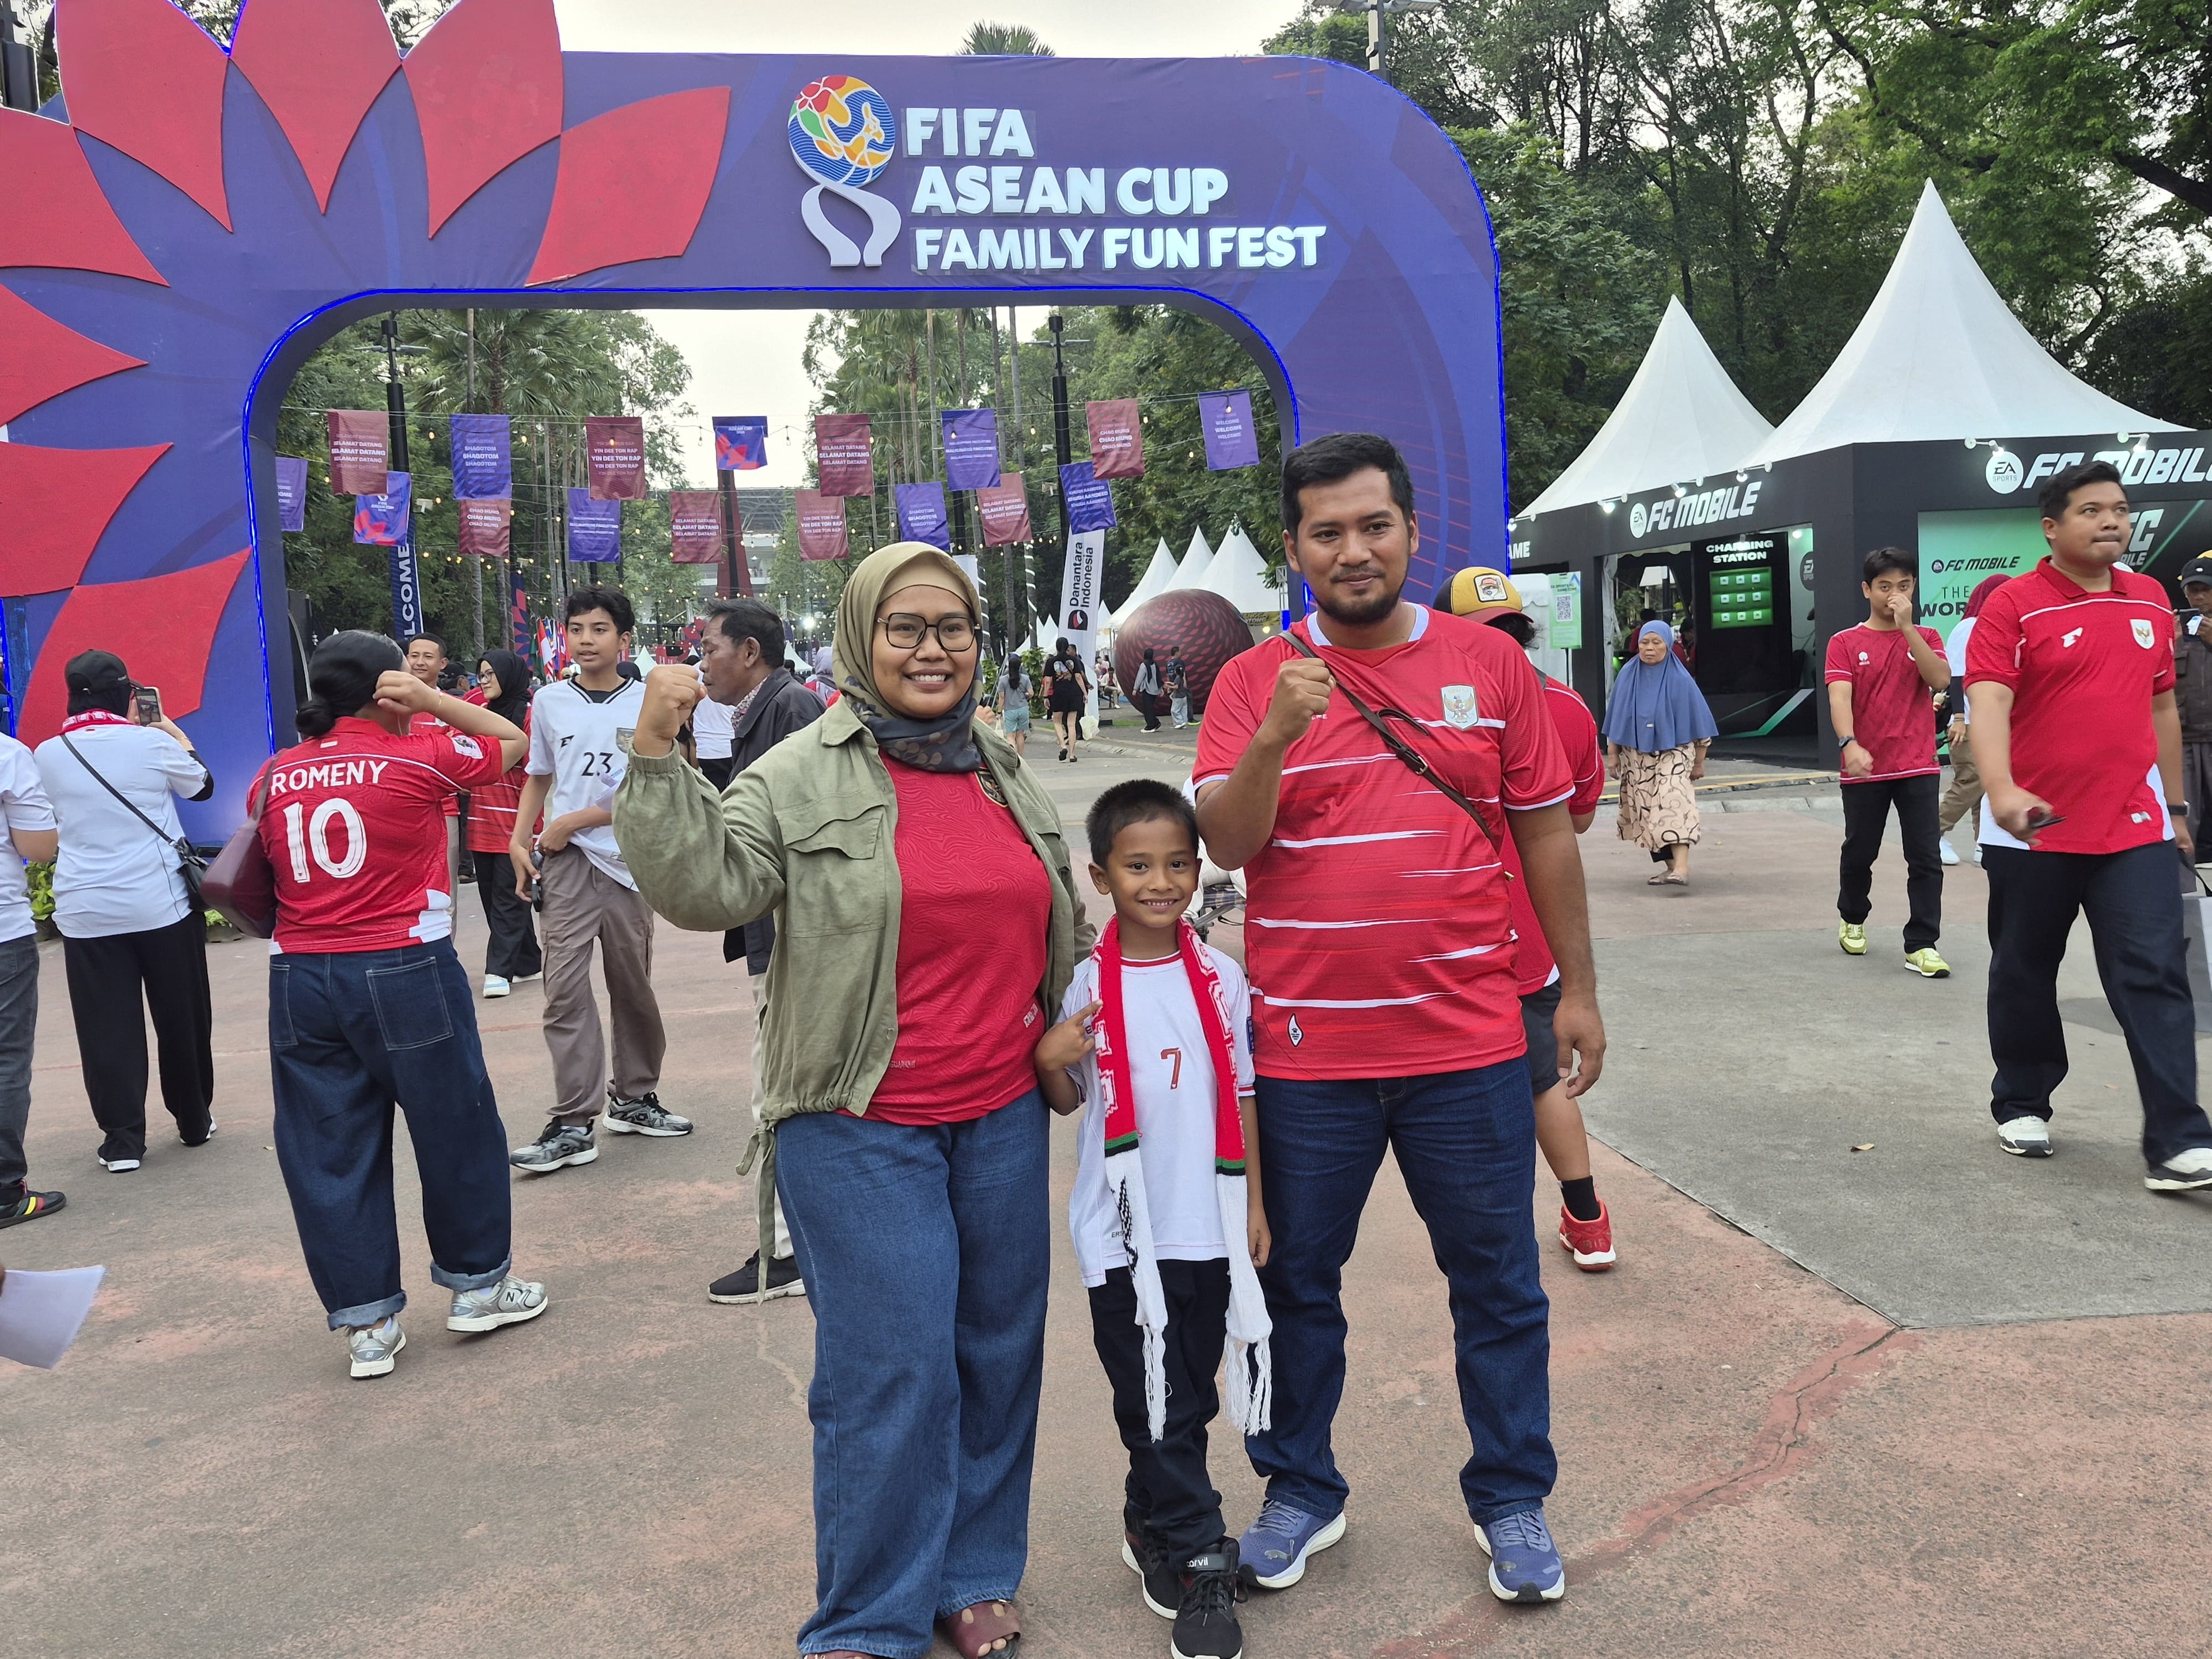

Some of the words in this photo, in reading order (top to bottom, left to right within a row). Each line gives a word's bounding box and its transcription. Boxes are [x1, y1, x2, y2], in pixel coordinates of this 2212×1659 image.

[906, 107, 1035, 157] FIFA
[911, 165, 1105, 214] ASEAN
[1116, 168, 1229, 215] CUP
[915, 227, 1094, 270] FAMILY
[1103, 228, 1200, 269] FUN
[1209, 226, 1327, 267] FEST
[1215, 425, 1243, 433] WELCOME
[1994, 462, 2016, 474] EA
[2092, 448, 2212, 486] MOBIL
[1634, 512, 1643, 522] EA
[1646, 499, 1675, 533] FC
[1673, 481, 1762, 529] MOBILE
[1070, 542, 1083, 607] Danantara
[1713, 551, 1767, 563] STATION
[1945, 559, 1965, 571] FC
[1965, 556, 2021, 570] MOBILE
[397, 543, 416, 637] LCOME
[1081, 547, 1093, 608] Indonesia
[1942, 586, 1970, 599] THE
[270, 760, 389, 796] ROMENY
[581, 752, 614, 777] 23
[282, 798, 367, 884] 10
[1160, 1047, 1183, 1090] 7
[506, 1291, 514, 1302] N
